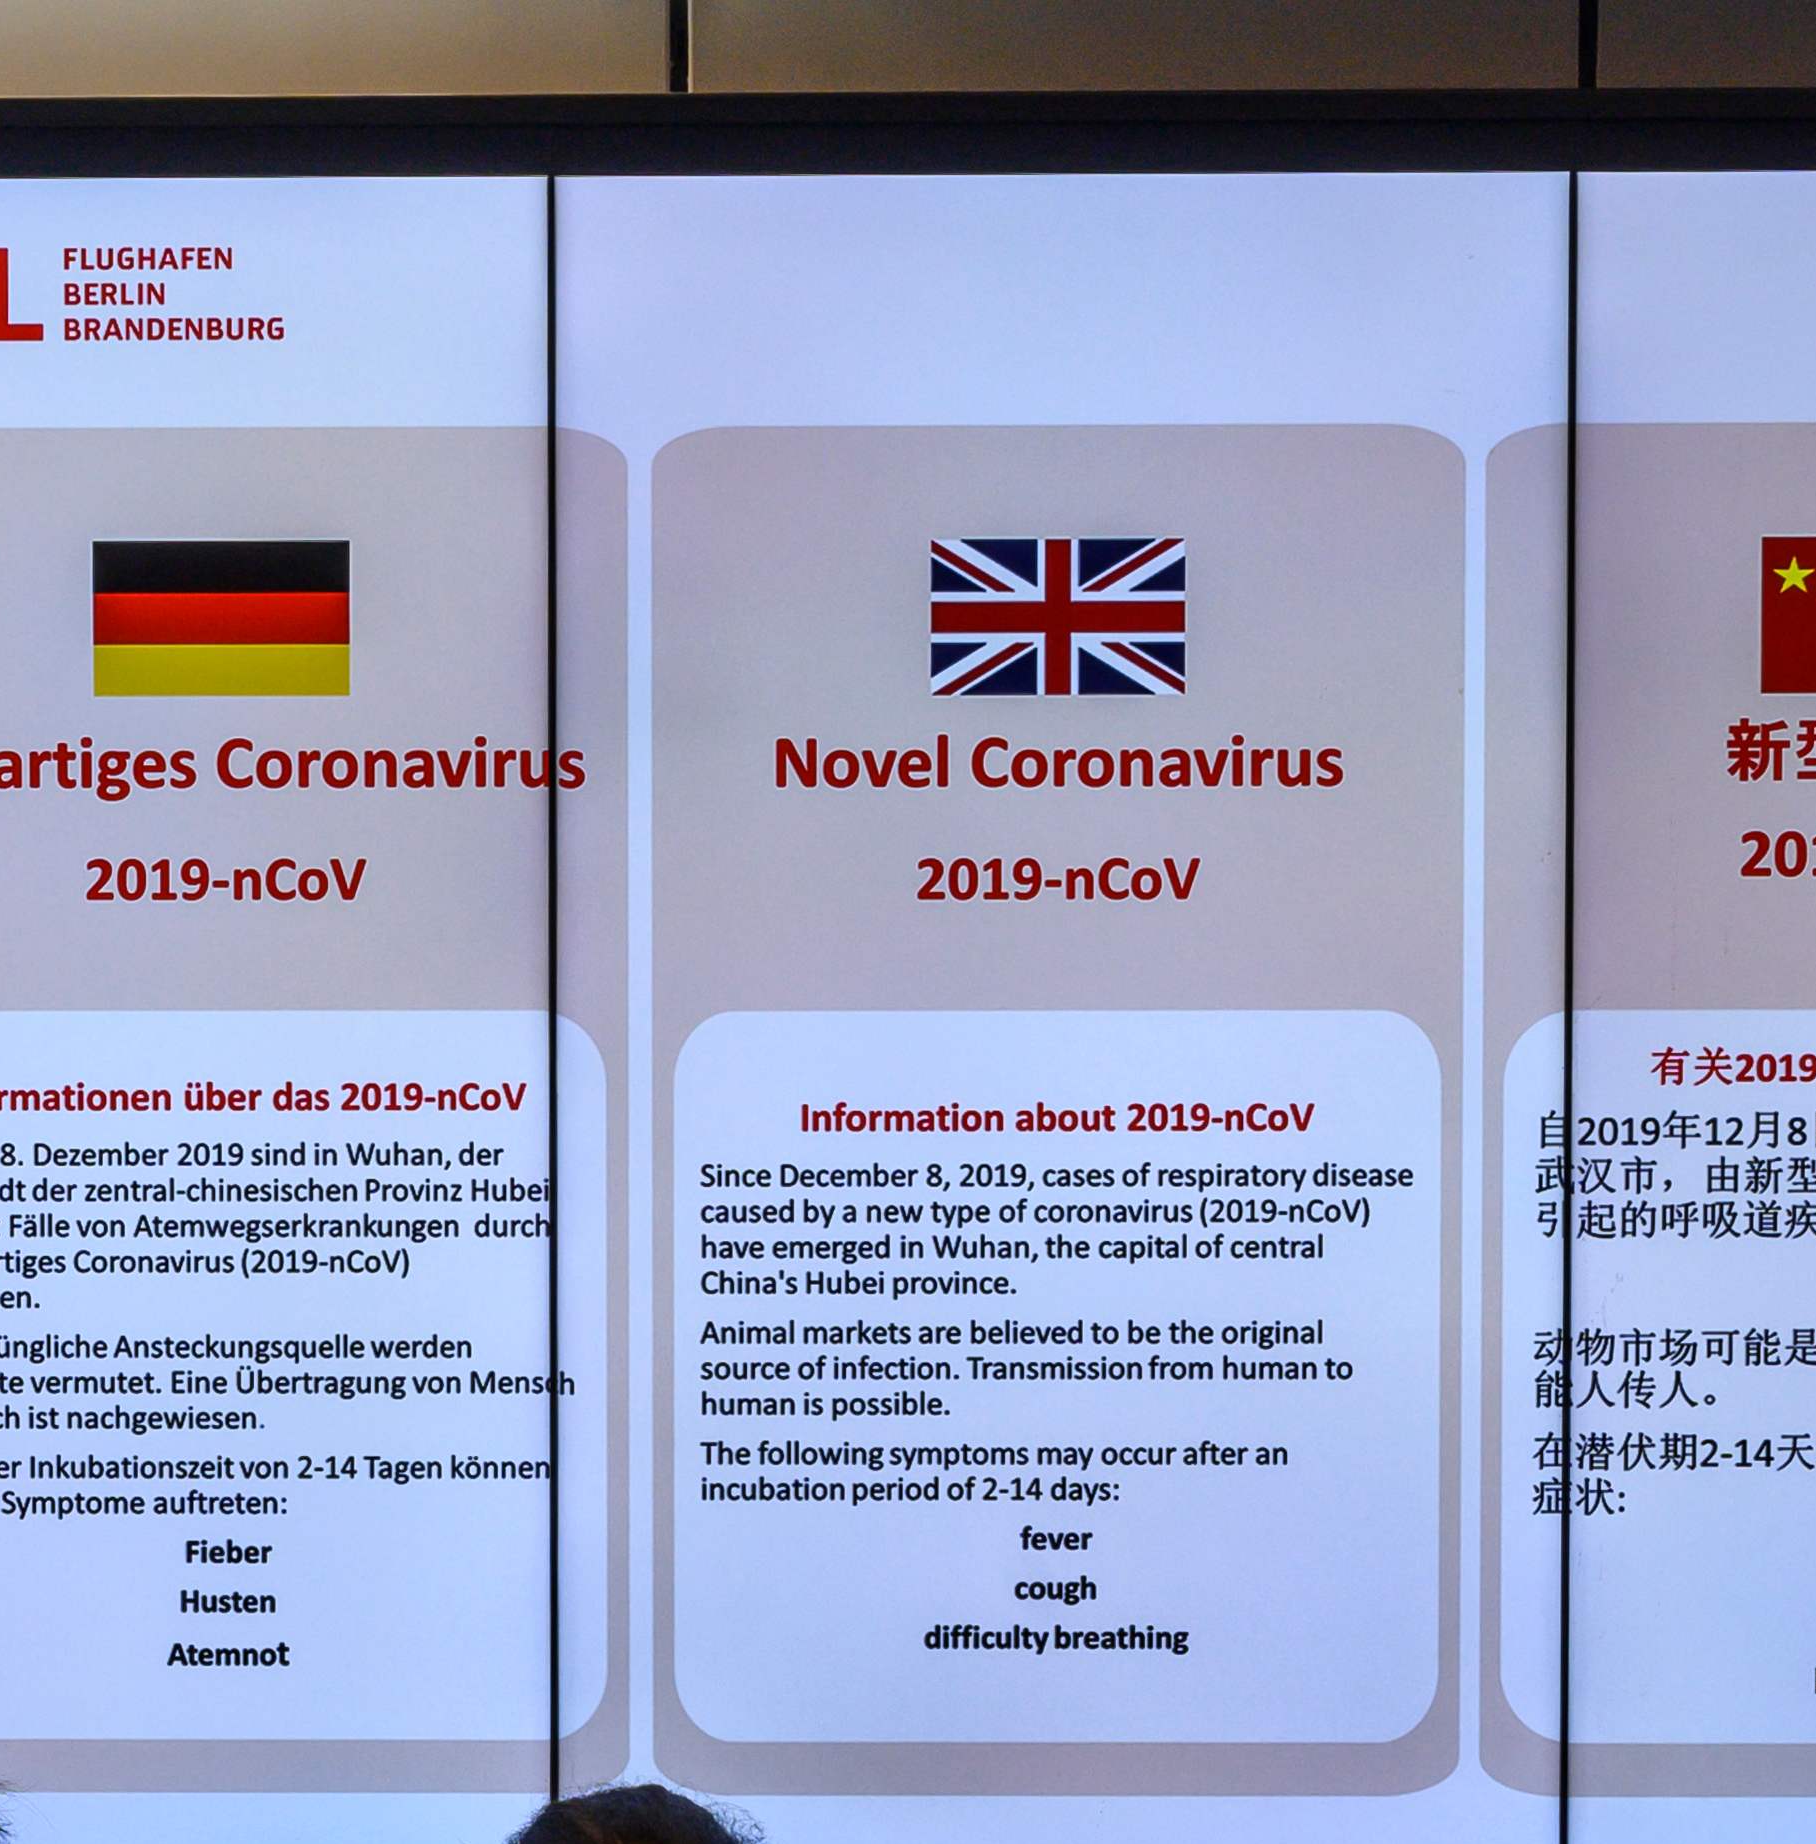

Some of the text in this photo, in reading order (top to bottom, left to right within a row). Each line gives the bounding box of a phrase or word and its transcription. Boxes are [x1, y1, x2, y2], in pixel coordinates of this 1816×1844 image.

[63, 246, 233, 271] FLUGHAFEN
[63, 282, 166, 307] BERLIN
[63, 316, 285, 342] BRANDENBURG
[215, 736, 587, 790] Coronavirus
[775, 733, 1344, 789] Novel Coronavirus
[85, 857, 368, 902] 2019-nCoV
[916, 857, 1201, 902] 2019-nCoV
[183, 1080, 263, 1112] über
[272, 1080, 331, 1112] das
[340, 1082, 528, 1112] 2019-nCoV
[800, 1101, 1316, 1133] Information about 2019-nCoV
[0, 1142, 24, 1167] 8.
[33, 1140, 170, 1167] Dezember
[176, 1142, 245, 1167] 2019
[250, 1140, 307, 1167] sind
[313, 1142, 338, 1167] in
[345, 1140, 452, 1171] Wuhan,
[457, 1140, 505, 1167] der
[31, 1176, 78, 1203] der
[83, 1176, 359, 1203] zentral-chinesischen
[364, 1177, 463, 1203] Provinz
[470, 1176, 550, 1203] Hubei
[699, 1161, 1414, 1194] Since December 8, 2019, cases of respiratory disease
[8, 1212, 71, 1239] Fälle
[75, 1218, 126, 1239] von
[132, 1211, 460, 1244] Atemwegserkrankungen
[473, 1212, 550, 1239] durch
[699, 1196, 1371, 1230] caused by a new type of coronavirus (2019-nCoV)
[72, 1248, 236, 1274] Coronavirus
[240, 1247, 410, 1280] (2019-nCoV)
[700, 1232, 1324, 1266] have emerged in Wuhan, the capital of central
[700, 1268, 1018, 1301] China's Hubei province.
[112, 1333, 366, 1365] Ansteckungsquelle
[369, 1333, 473, 1360] werden
[699, 1318, 1324, 1351] Animal markets are believed to be the original
[29, 1369, 163, 1395] vermutet.
[170, 1369, 228, 1395] Eine
[236, 1365, 407, 1401] Übertragung
[411, 1375, 462, 1395] von
[699, 1353, 1354, 1381] source of infection. Transmission from human to
[27, 1405, 60, 1430] ist
[66, 1403, 266, 1436] nachgewiesen.
[701, 1389, 951, 1422] human is possible.
[29, 1453, 236, 1480] Inkubationszeit
[238, 1460, 289, 1480] von
[296, 1455, 359, 1480] 2-14
[362, 1455, 443, 1486] Tagen
[450, 1453, 550, 1480] können
[699, 1439, 1289, 1472] The following symptoms may occur after an
[0, 1490, 146, 1521] Symptome
[152, 1488, 288, 1516] auftreten:
[700, 1475, 1120, 1507] incubation period of 2-14 days:
[185, 1538, 274, 1565] Fieber
[1018, 1524, 1094, 1552] fever
[179, 1588, 277, 1614] Husten
[1013, 1574, 1098, 1607] cough
[166, 1641, 291, 1667] Atemnot
[923, 1623, 1190, 1656] difficulty breathing
